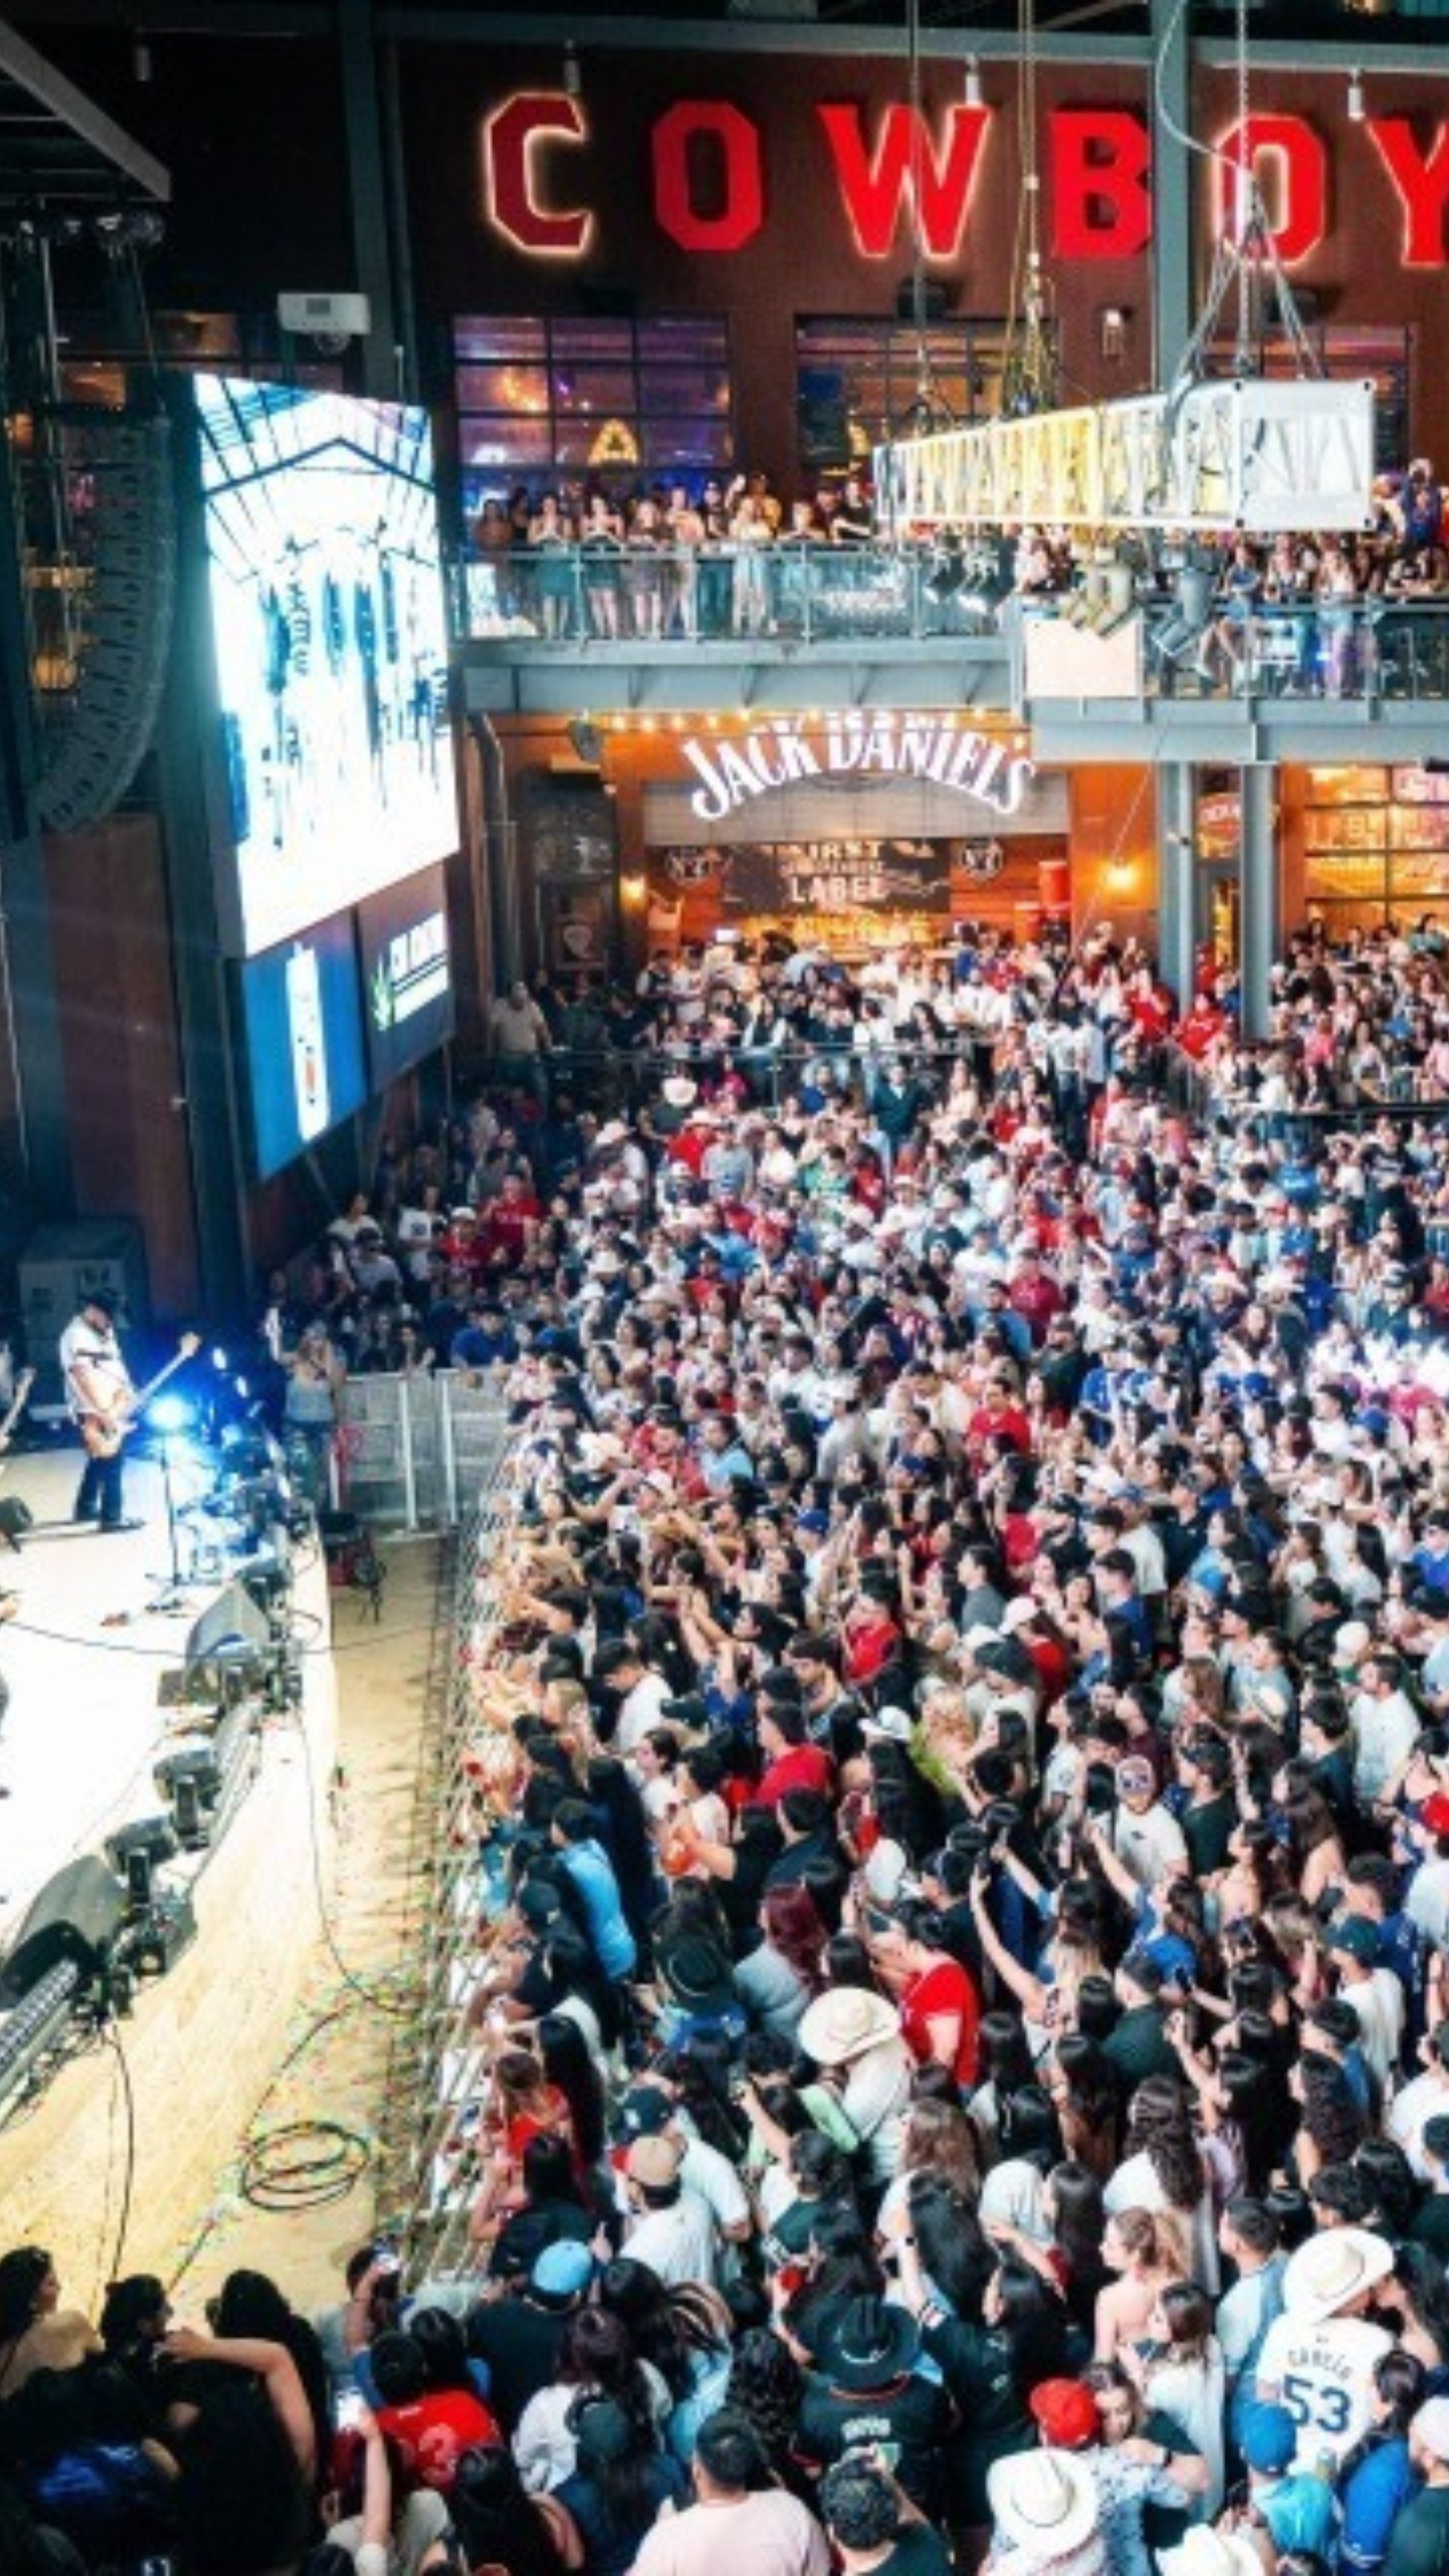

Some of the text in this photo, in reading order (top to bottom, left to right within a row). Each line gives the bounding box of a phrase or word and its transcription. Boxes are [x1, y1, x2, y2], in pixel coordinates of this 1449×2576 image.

[483, 93, 1449, 268] COWBOY
[682, 719, 822, 820] JACK
[792, 875, 888, 904] LABEL
[1284, 2373, 1354, 2434] 53
